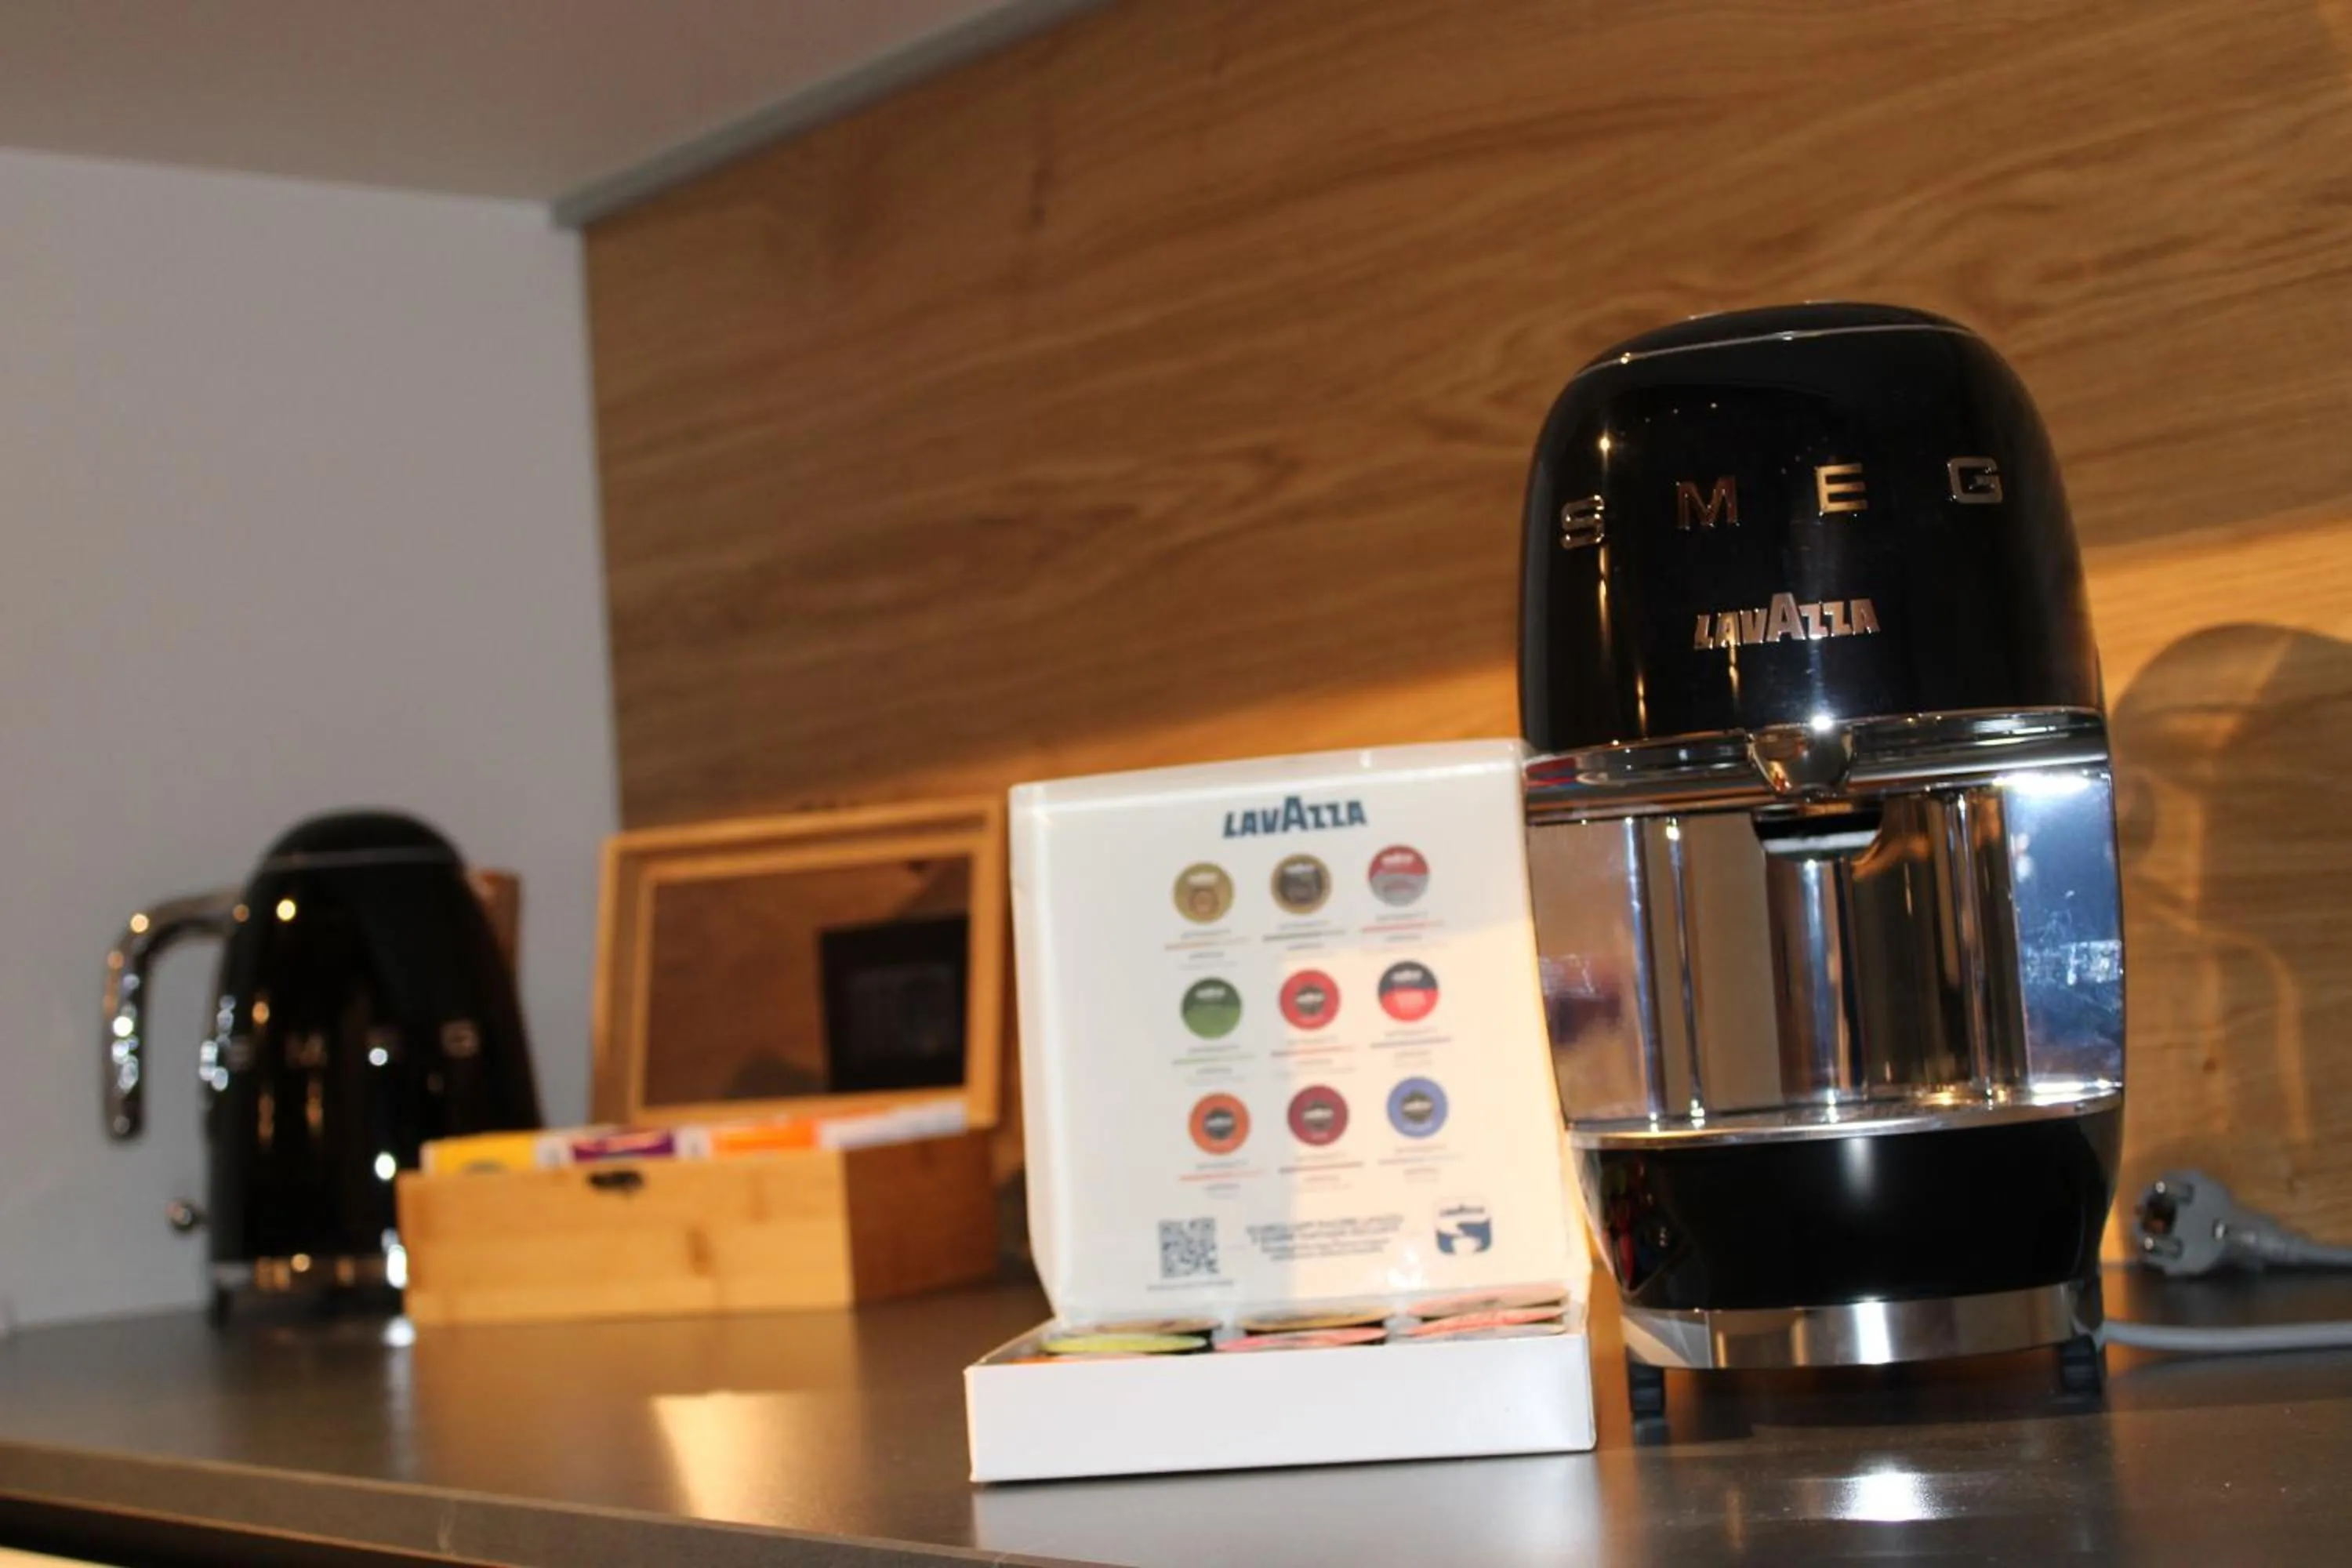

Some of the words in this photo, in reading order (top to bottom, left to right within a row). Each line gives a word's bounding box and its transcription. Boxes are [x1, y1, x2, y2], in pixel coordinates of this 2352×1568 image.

[1560, 456, 2004, 549] SMEG
[1693, 592, 1880, 649] LAVAZZA
[1221, 795, 1367, 838] LAVAZZA
